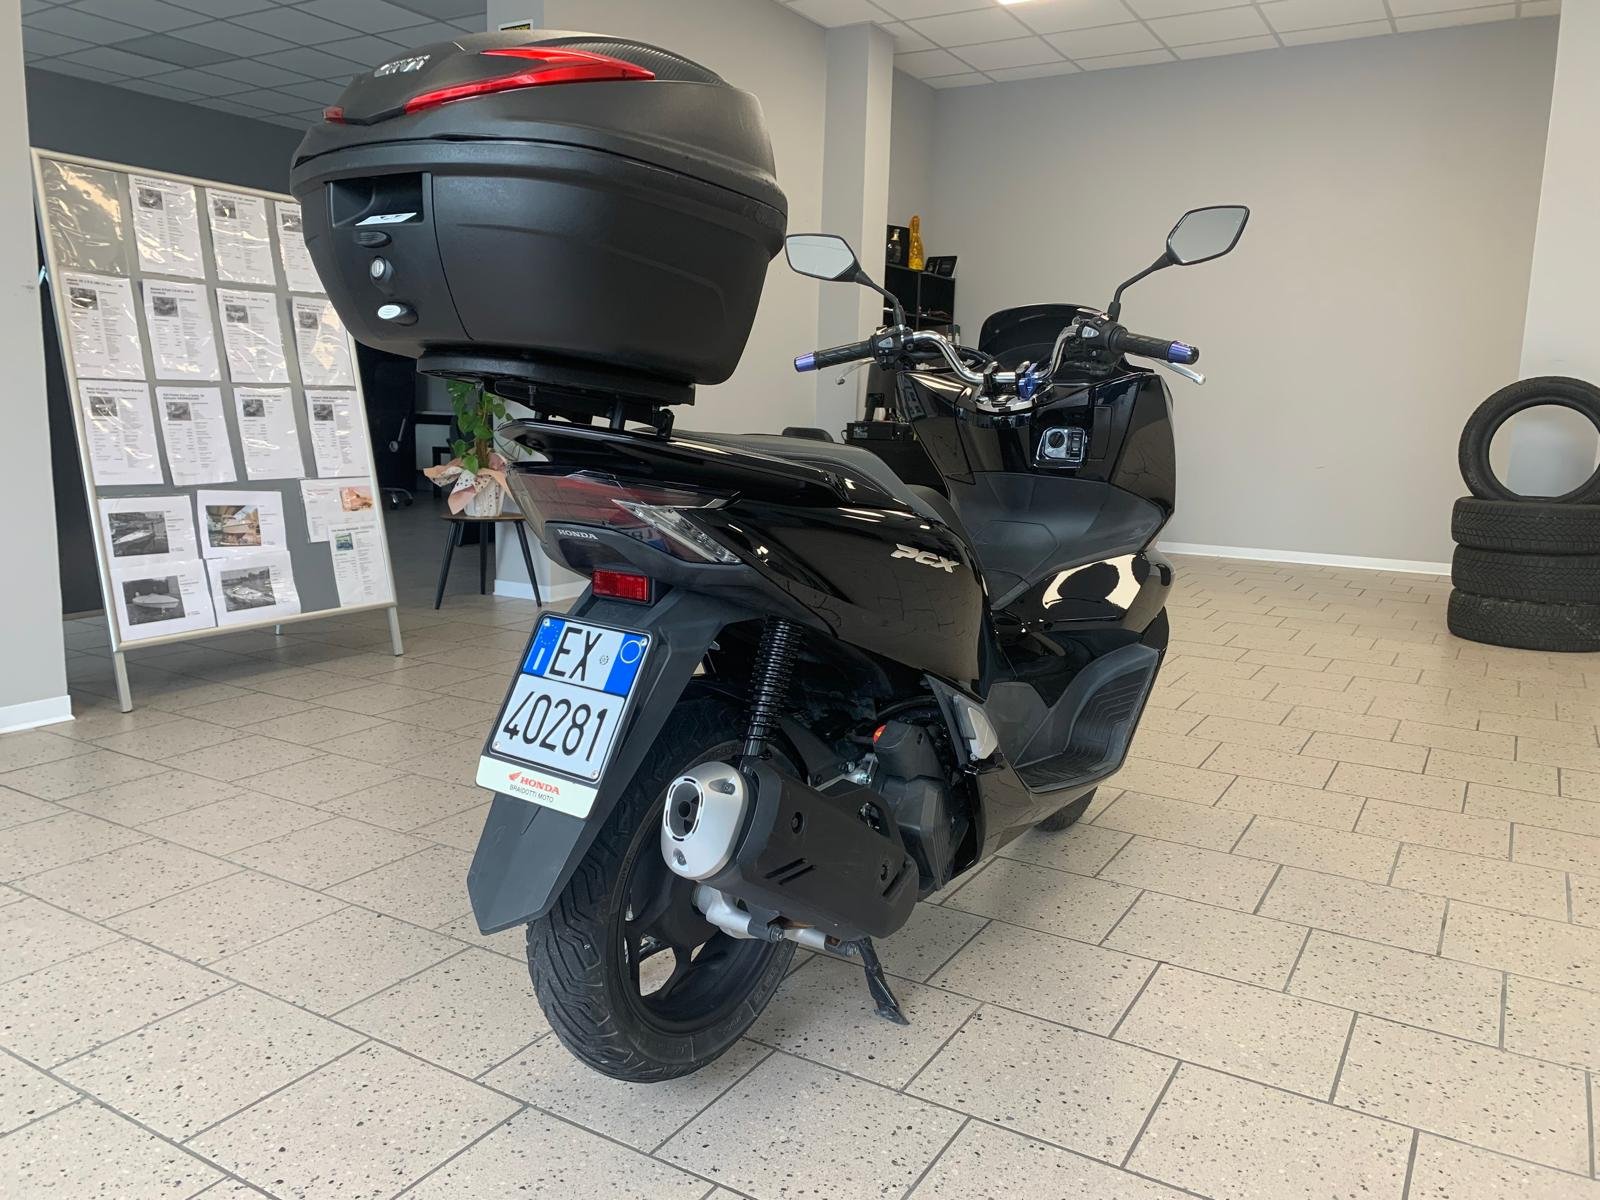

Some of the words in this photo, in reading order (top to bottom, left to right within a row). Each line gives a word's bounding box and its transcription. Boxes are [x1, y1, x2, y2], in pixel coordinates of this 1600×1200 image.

[557, 528, 599, 541] HONDA
[890, 543, 960, 573] PCX
[548, 626, 603, 682] EX
[502, 691, 609, 762] 40281
[509, 783, 537, 798] BRAIDOTTI
[536, 792, 554, 803] MOTO
[520, 776, 560, 796] HONDA
